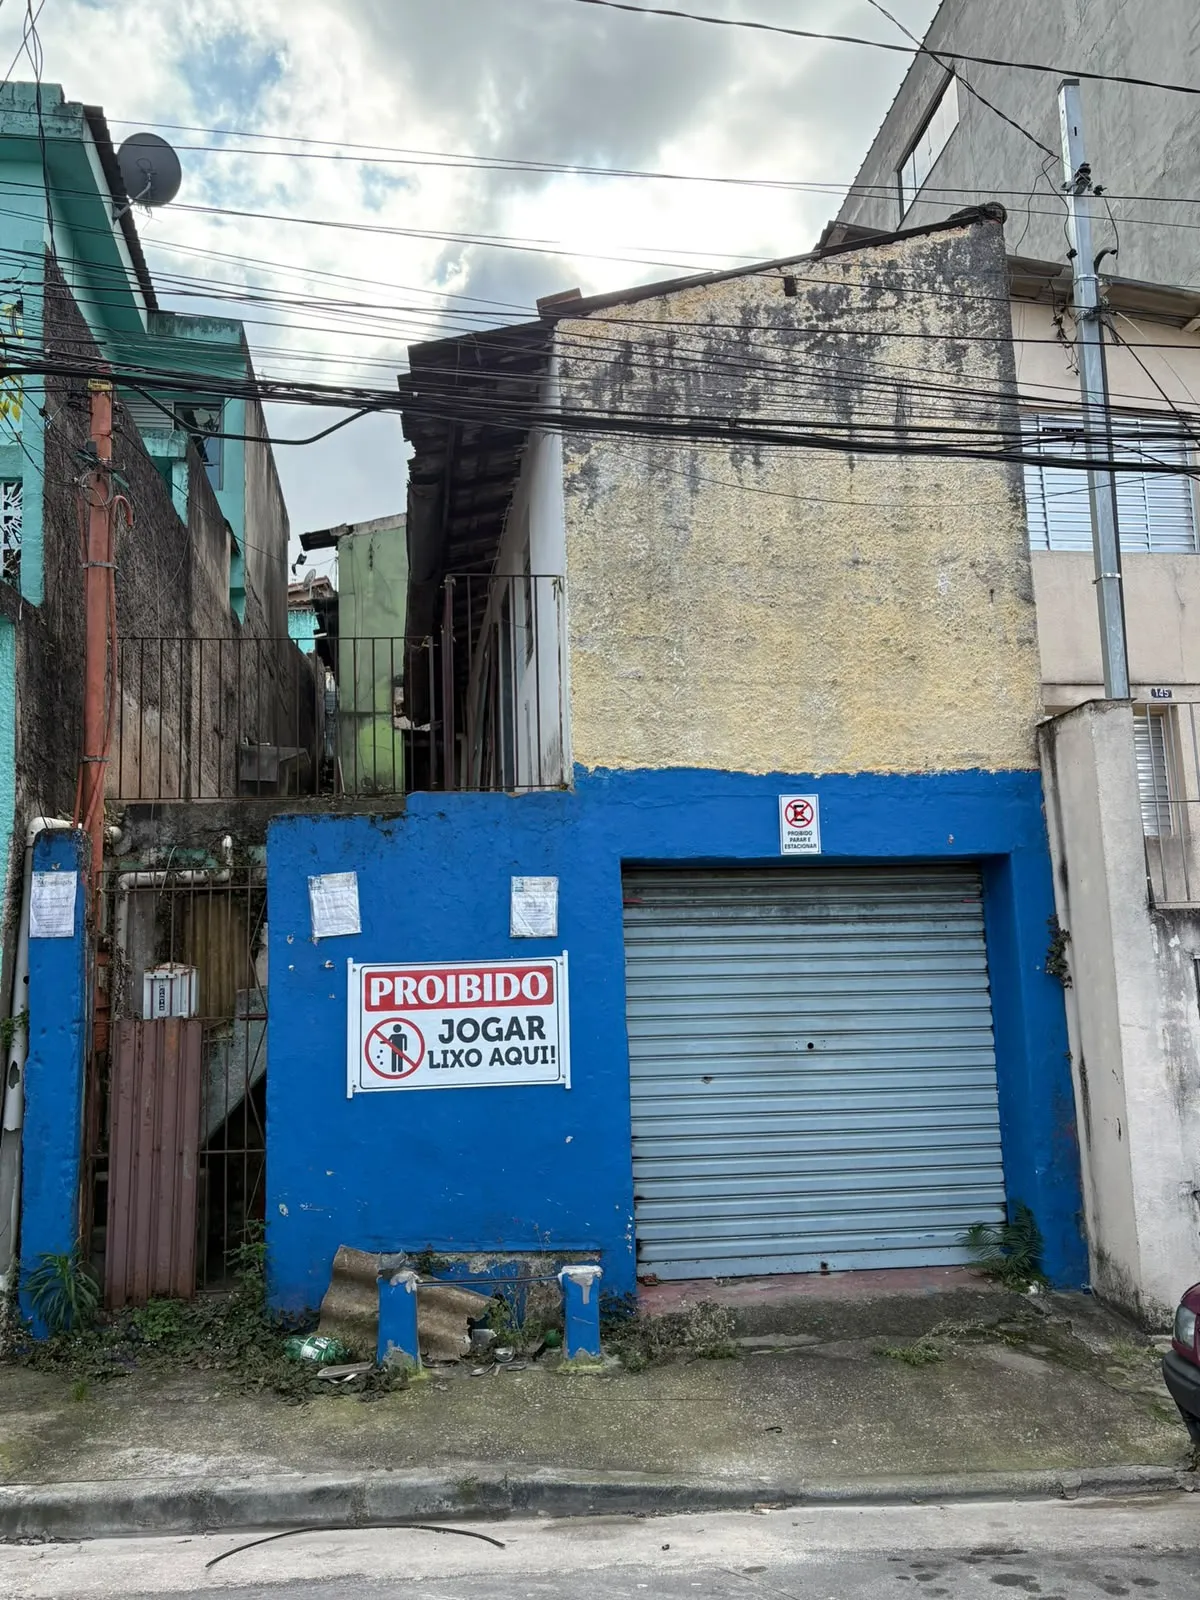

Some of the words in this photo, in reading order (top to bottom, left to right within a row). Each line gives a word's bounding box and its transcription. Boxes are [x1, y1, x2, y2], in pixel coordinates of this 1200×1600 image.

[1154, 687, 1169, 698] 145
[793, 804, 805, 822] E
[370, 971, 548, 1006] PROIBIDO
[438, 1015, 546, 1044] JOGAR
[427, 1048, 482, 1069] LIXO
[488, 1045, 556, 1067] AQUI!
